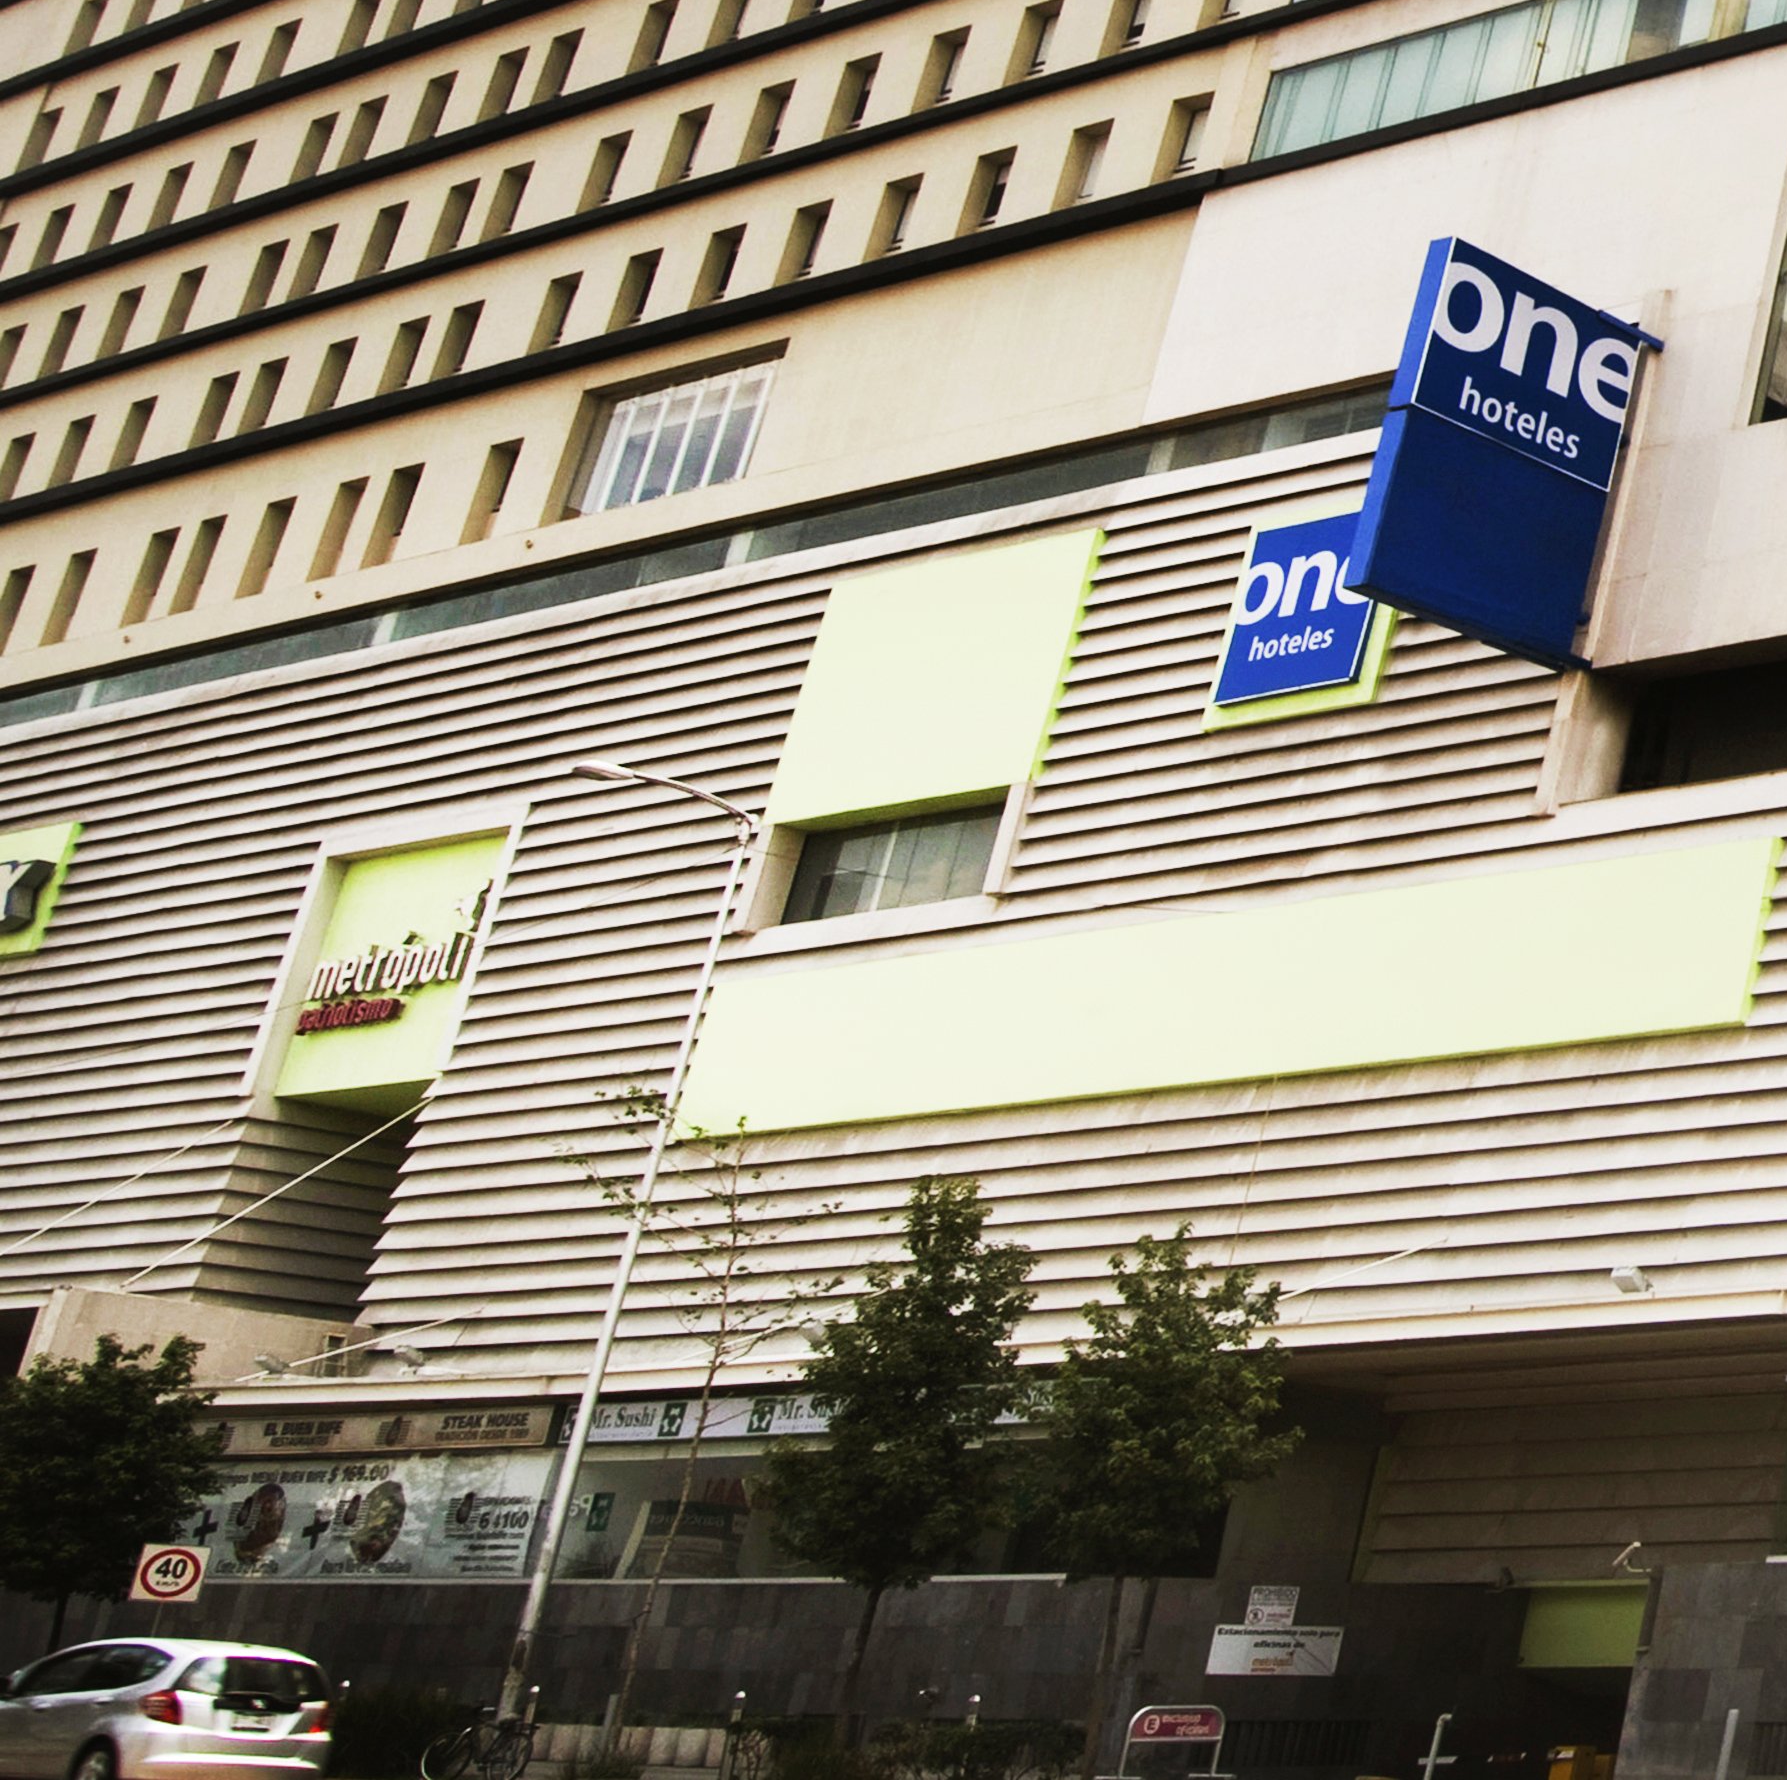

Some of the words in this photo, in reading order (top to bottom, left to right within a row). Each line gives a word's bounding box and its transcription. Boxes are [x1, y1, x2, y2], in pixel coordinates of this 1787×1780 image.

[1433, 261, 1638, 423] one
[1459, 376, 1580, 460] hoteles
[1248, 626, 1333, 662] hoteles
[614, 1405, 657, 1428] Sushi
[776, 1399, 804, 1419] Mr.
[442, 1414, 486, 1430] STEAK
[486, 1412, 530, 1427] HOUSE
[155, 1558, 188, 1579] 40
[1217, 1627, 1298, 1637] Estacionamiento
[1253, 1639, 1292, 1649] oficinas
